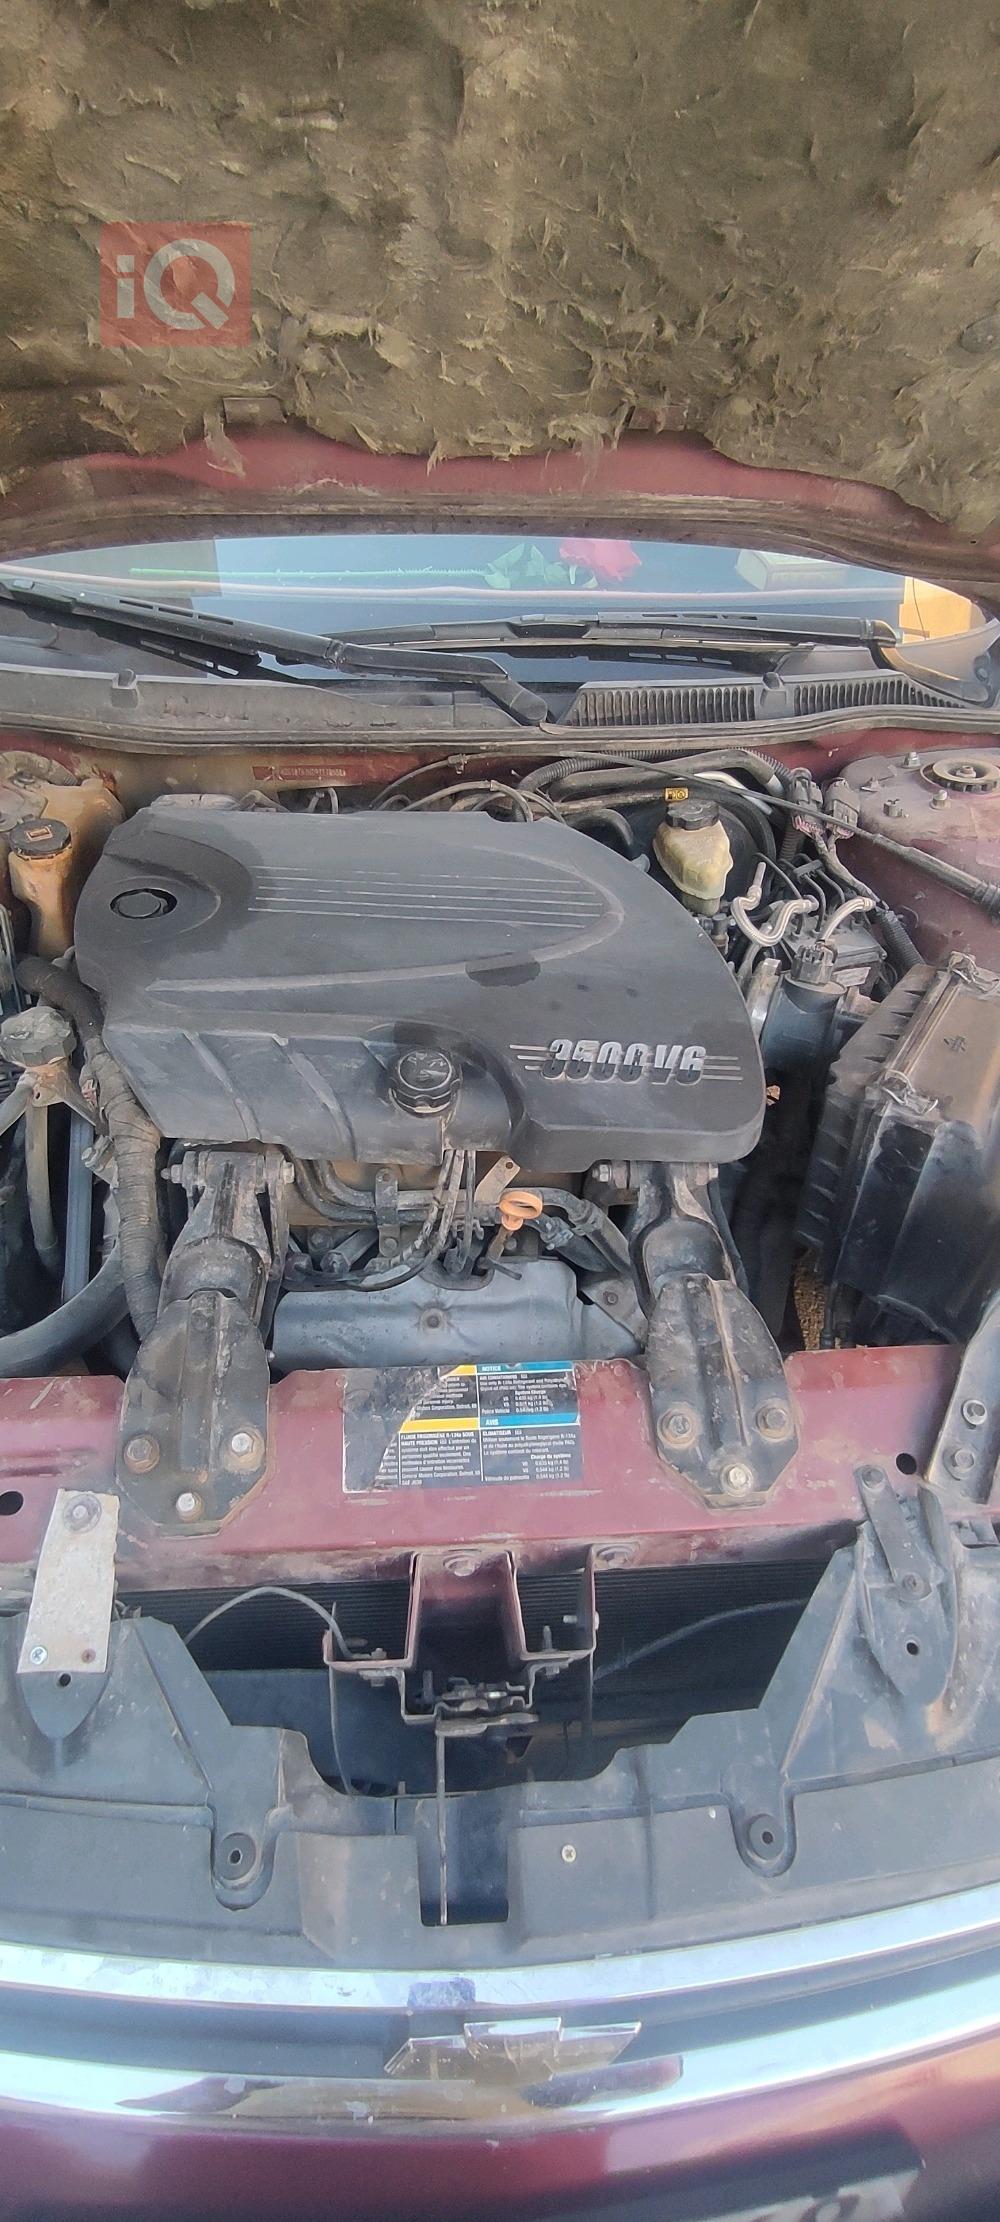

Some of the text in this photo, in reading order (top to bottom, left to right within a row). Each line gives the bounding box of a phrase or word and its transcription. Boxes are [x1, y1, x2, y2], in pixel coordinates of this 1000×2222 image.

[541, 1039, 707, 1086] 3500 V6
[485, 1418, 499, 1426] AVIS
